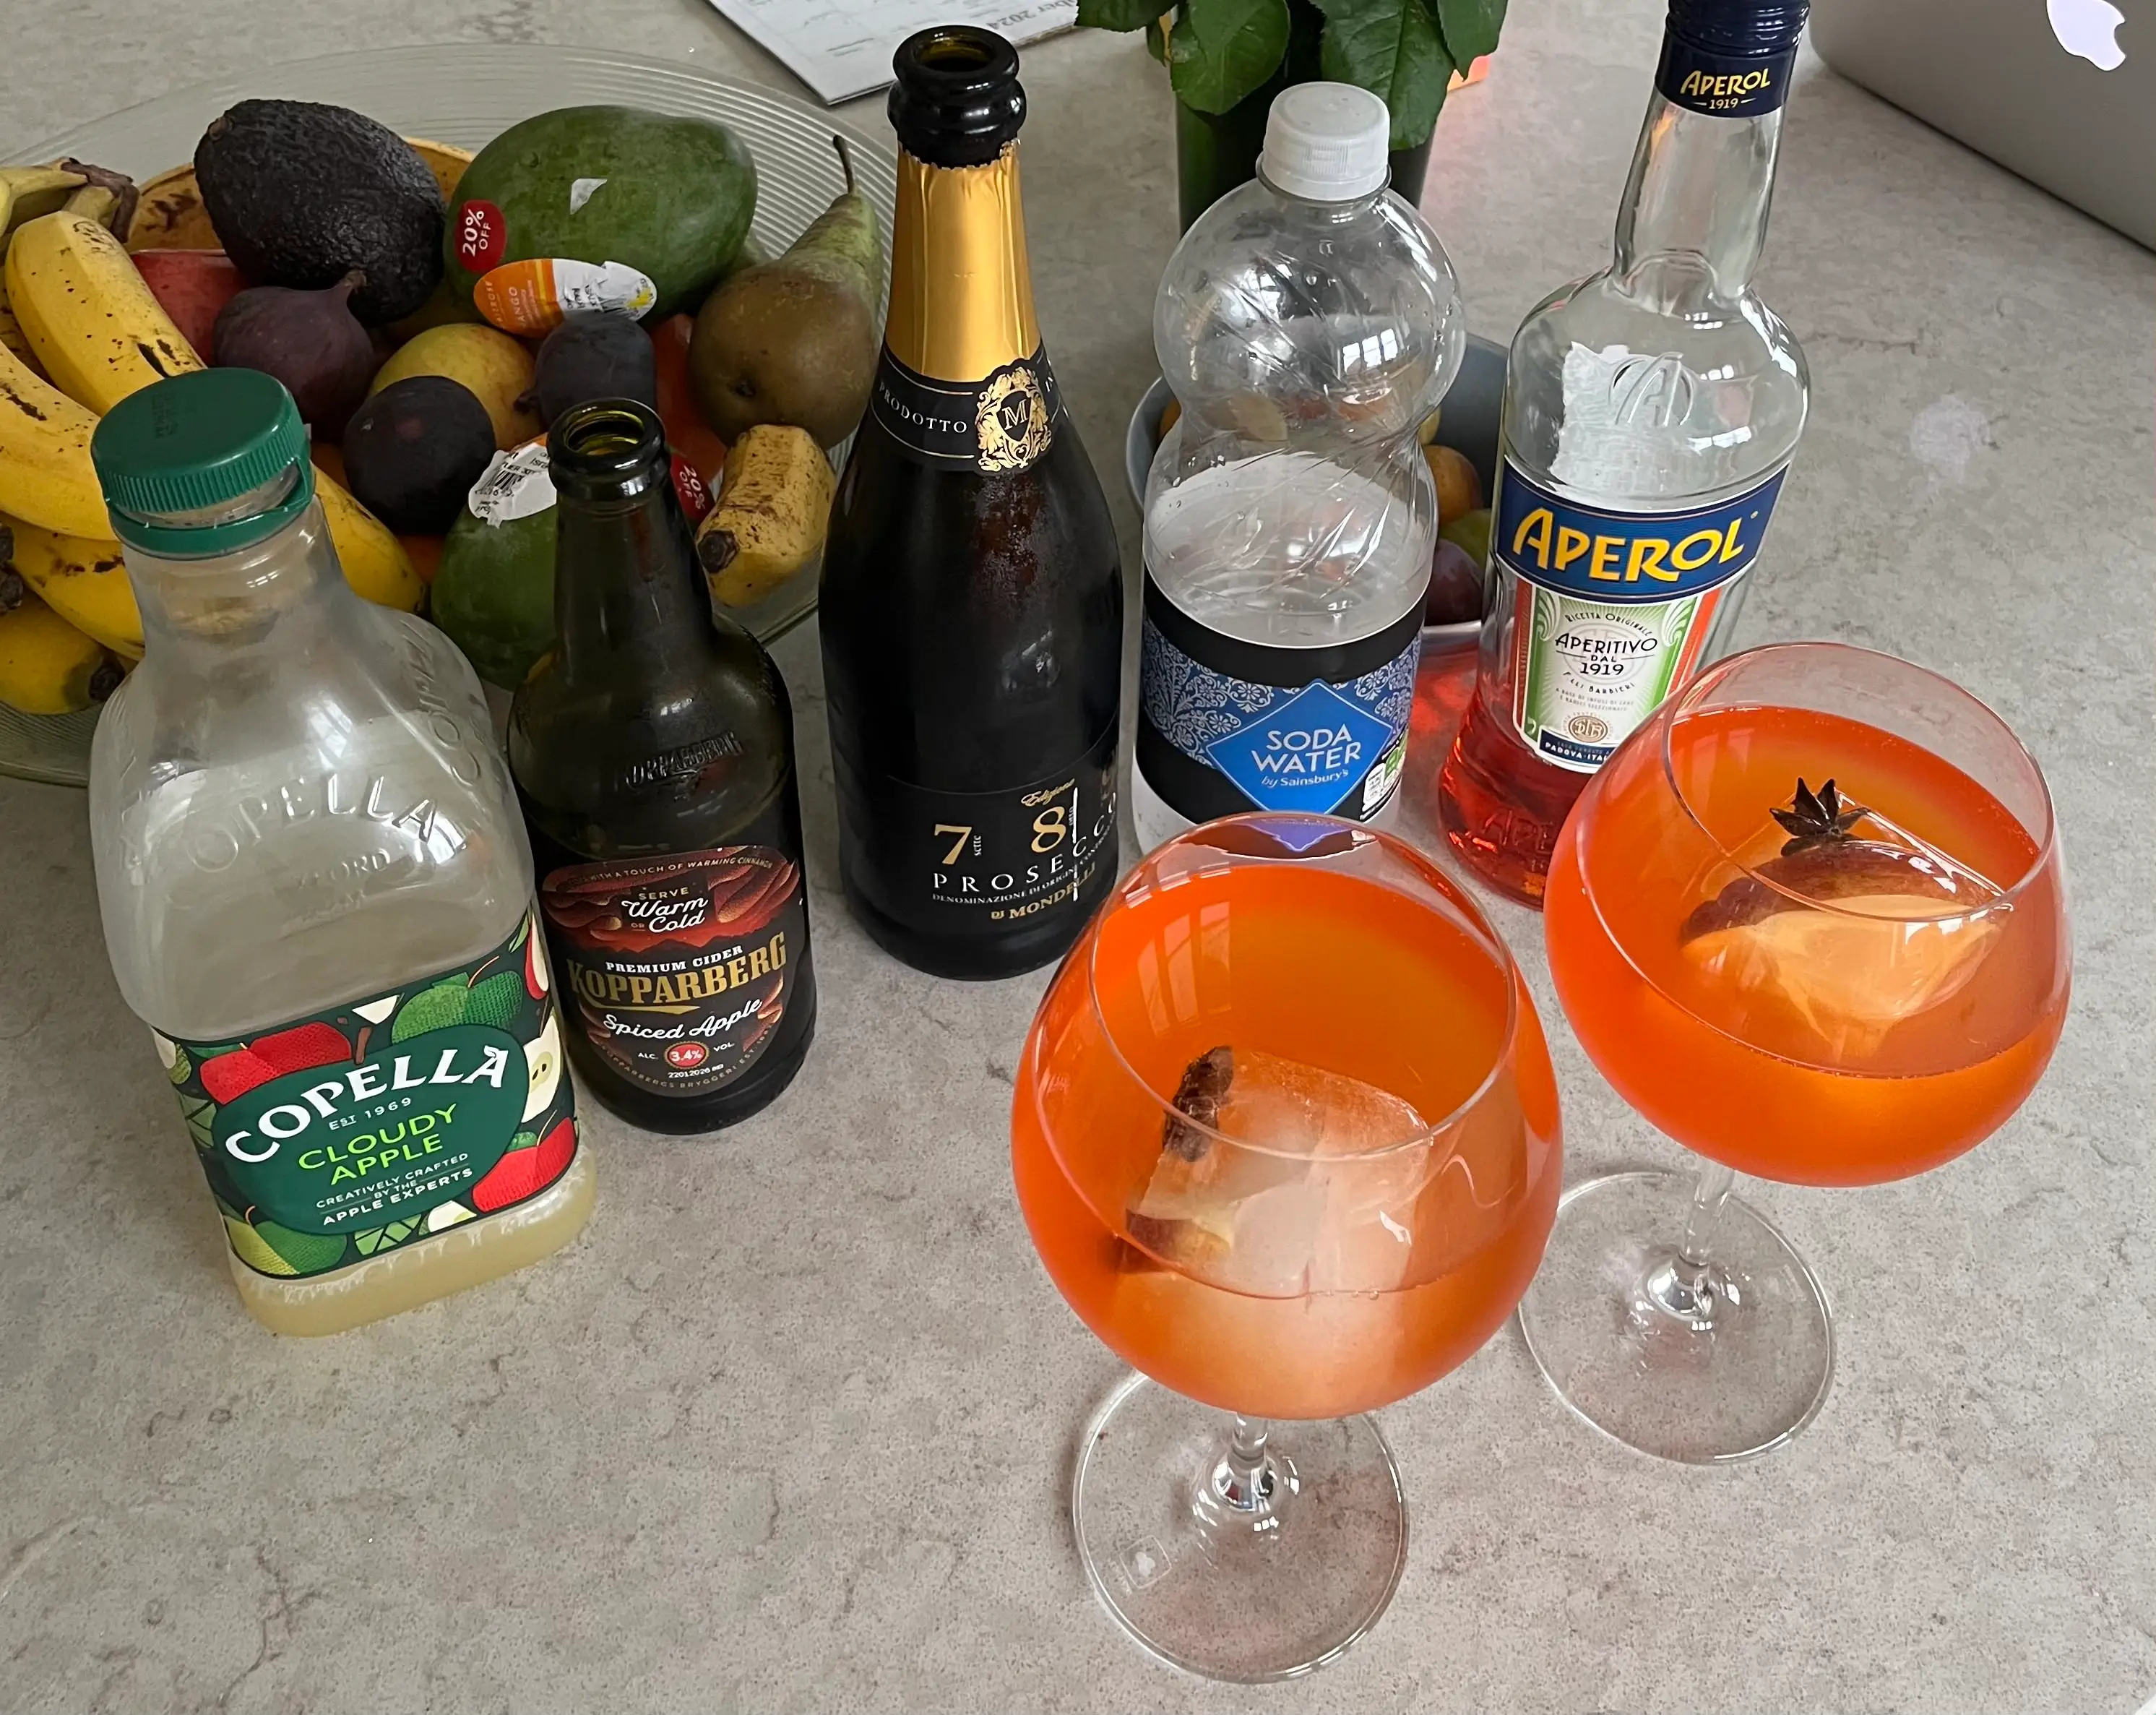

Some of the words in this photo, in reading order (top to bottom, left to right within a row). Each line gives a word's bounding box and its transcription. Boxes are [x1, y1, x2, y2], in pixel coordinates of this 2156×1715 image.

[986, 10, 1035, 30] 2024
[1680, 68, 1770, 96] APEROL
[1709, 98, 1738, 109] 1919
[462, 209, 484, 257] 20%
[478, 222, 491, 250] OFF
[879, 381, 967, 434] PRODOTTO
[1001, 399, 1029, 431] M
[1512, 507, 1745, 583] APEROL
[1565, 612, 1601, 622] RICETTA
[1605, 613, 1653, 637] ORIGINALE
[1555, 632, 1658, 655] APERITIVO
[1579, 662, 1624, 676] 1919
[1588, 682, 1635, 694] BARBIERI
[1266, 723, 1352, 752] SODA
[1545, 742, 1582, 759] PADOVA
[1250, 741, 1361, 774] WATER
[1261, 775, 1278, 788] by
[1280, 768, 1349, 788] Sainsbury's
[1030, 806, 1067, 853] 8
[933, 823, 972, 865] 7
[624, 866, 664, 877] TOUCH
[687, 856, 736, 869] WARMING
[621, 896, 709, 918] Warm
[639, 886, 689, 901] SERVE
[932, 889, 1027, 904] DENOMINAZIONE
[1029, 885, 1040, 895] DI
[649, 909, 705, 934] Cold
[566, 931, 787, 1004] KOPPARBERG
[605, 960, 686, 973] PREMIUM
[692, 945, 743, 968] CIDER
[603, 1014, 685, 1039] Spiced
[688, 998, 763, 1037] Apple
[670, 1049, 703, 1062] 3.4%
[668, 1067, 711, 1078] 22012026
[225, 1046, 509, 1163] COPELLA
[329, 1114, 357, 1131] EST
[365, 1097, 412, 1119] 1969
[298, 1103, 457, 1169] CLOUDY
[331, 1133, 443, 1185] APPLE
[316, 1176, 400, 1208] CREATIVELY
[405, 1153, 468, 1180] CRAFTED
[374, 1189, 389, 1200] BY
[394, 1179, 418, 1192] THE
[323, 1199, 384, 1226] APPLE
[389, 1168, 473, 1204] EXPERTS
